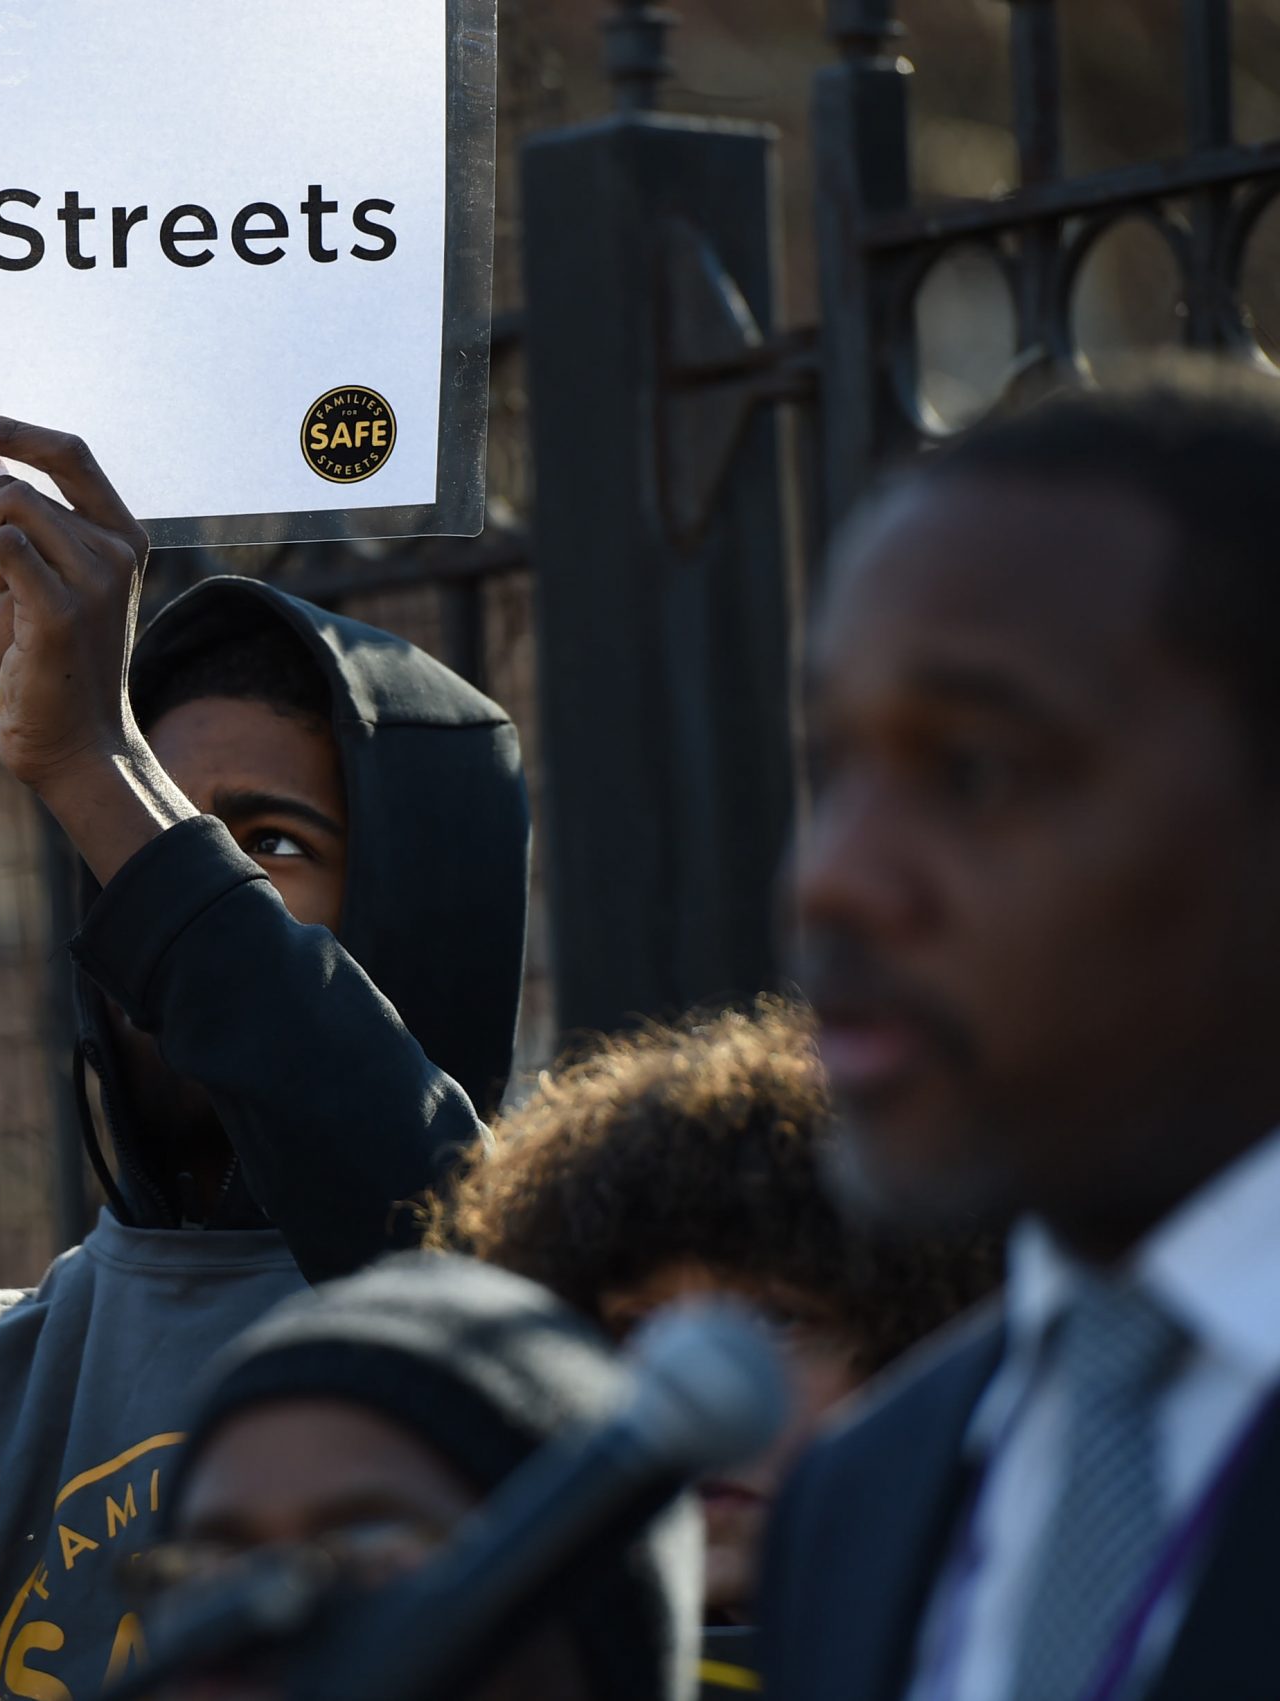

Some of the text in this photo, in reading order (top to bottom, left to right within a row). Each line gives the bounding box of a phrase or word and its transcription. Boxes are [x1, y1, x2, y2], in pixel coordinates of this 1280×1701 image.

[316, 394, 383, 419] FAMILIES
[310, 420, 387, 450] SAFE
[317, 452, 379, 475] STREETS
